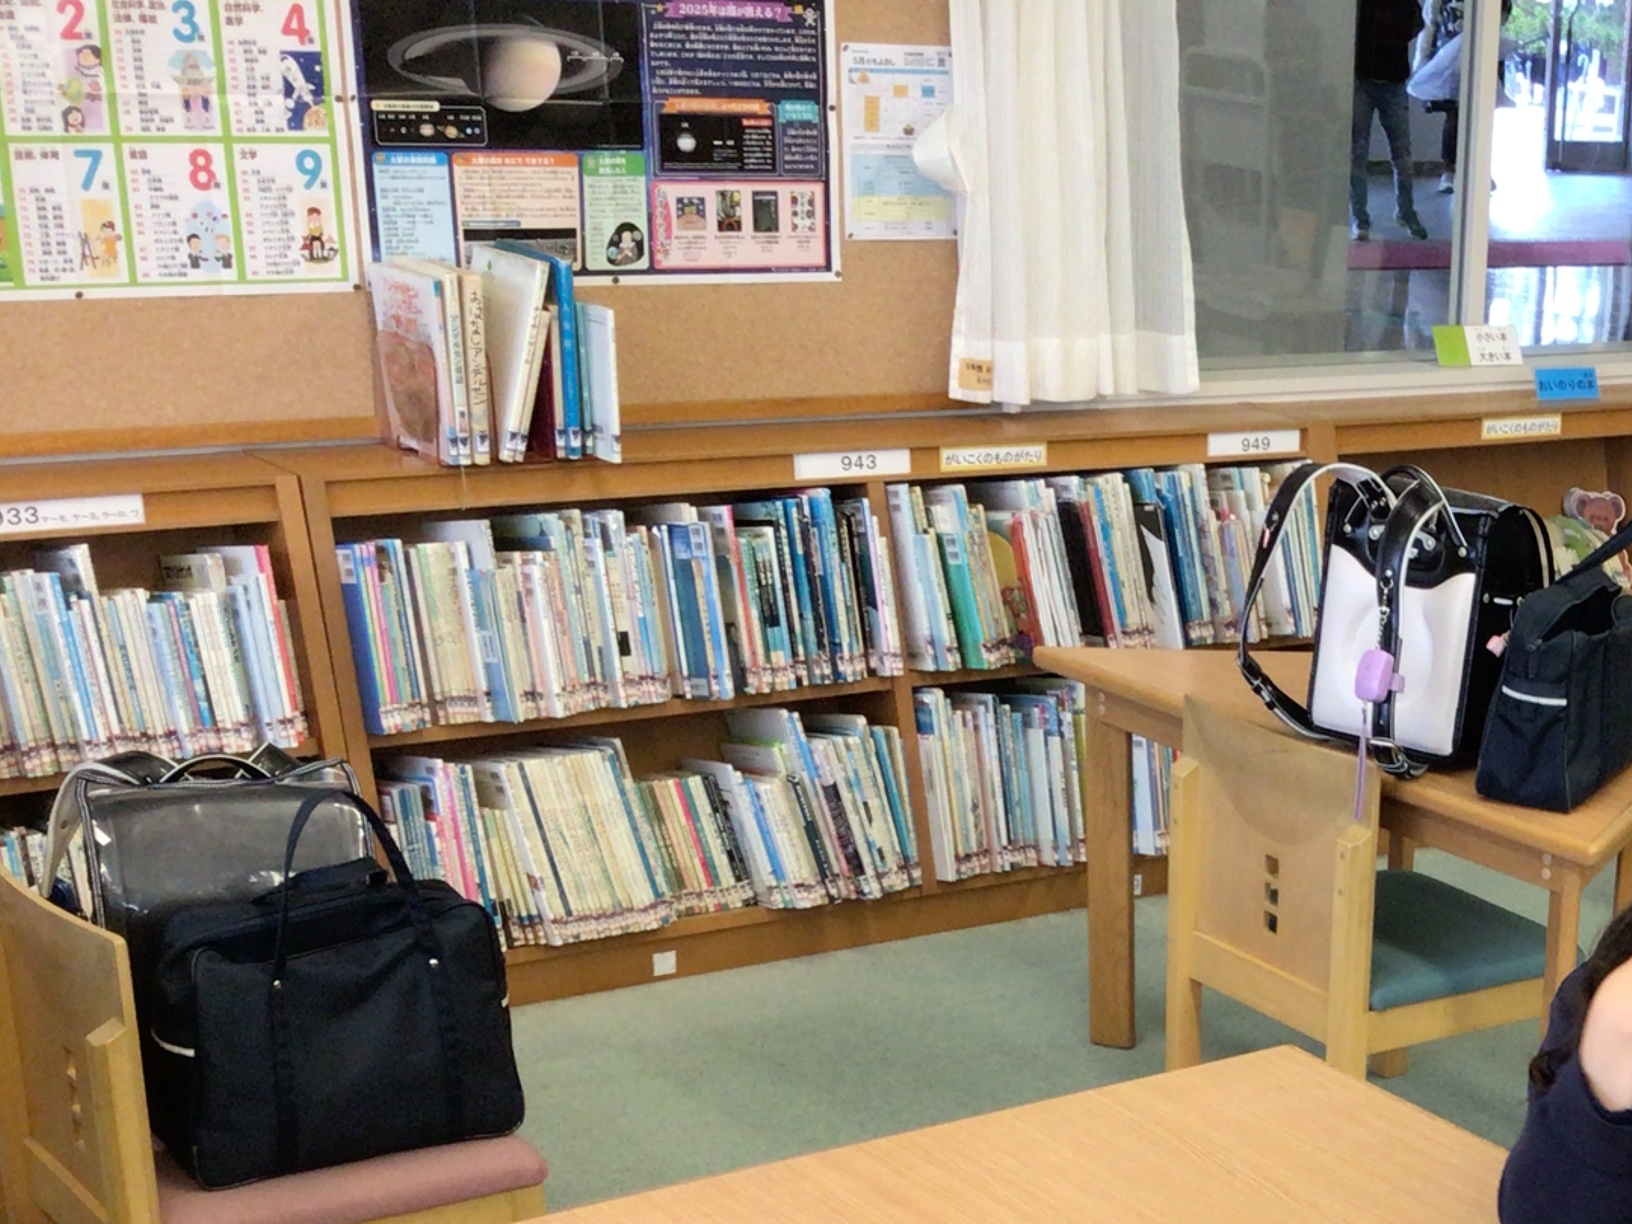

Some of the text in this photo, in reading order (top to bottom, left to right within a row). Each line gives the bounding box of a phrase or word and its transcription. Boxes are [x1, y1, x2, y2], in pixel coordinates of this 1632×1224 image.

[56, 0, 84, 40] 2
[172, 1, 199, 43] 3
[281, 3, 311, 45] 4
[73, 150, 103, 191] 7
[189, 149, 216, 190] 8
[295, 149, 322, 190] 9
[841, 454, 877, 471] 943
[945, 450, 1043, 466] がいこくのものがたり
[1241, 436, 1271, 453] 949
[0, 506, 39, 526] 33
